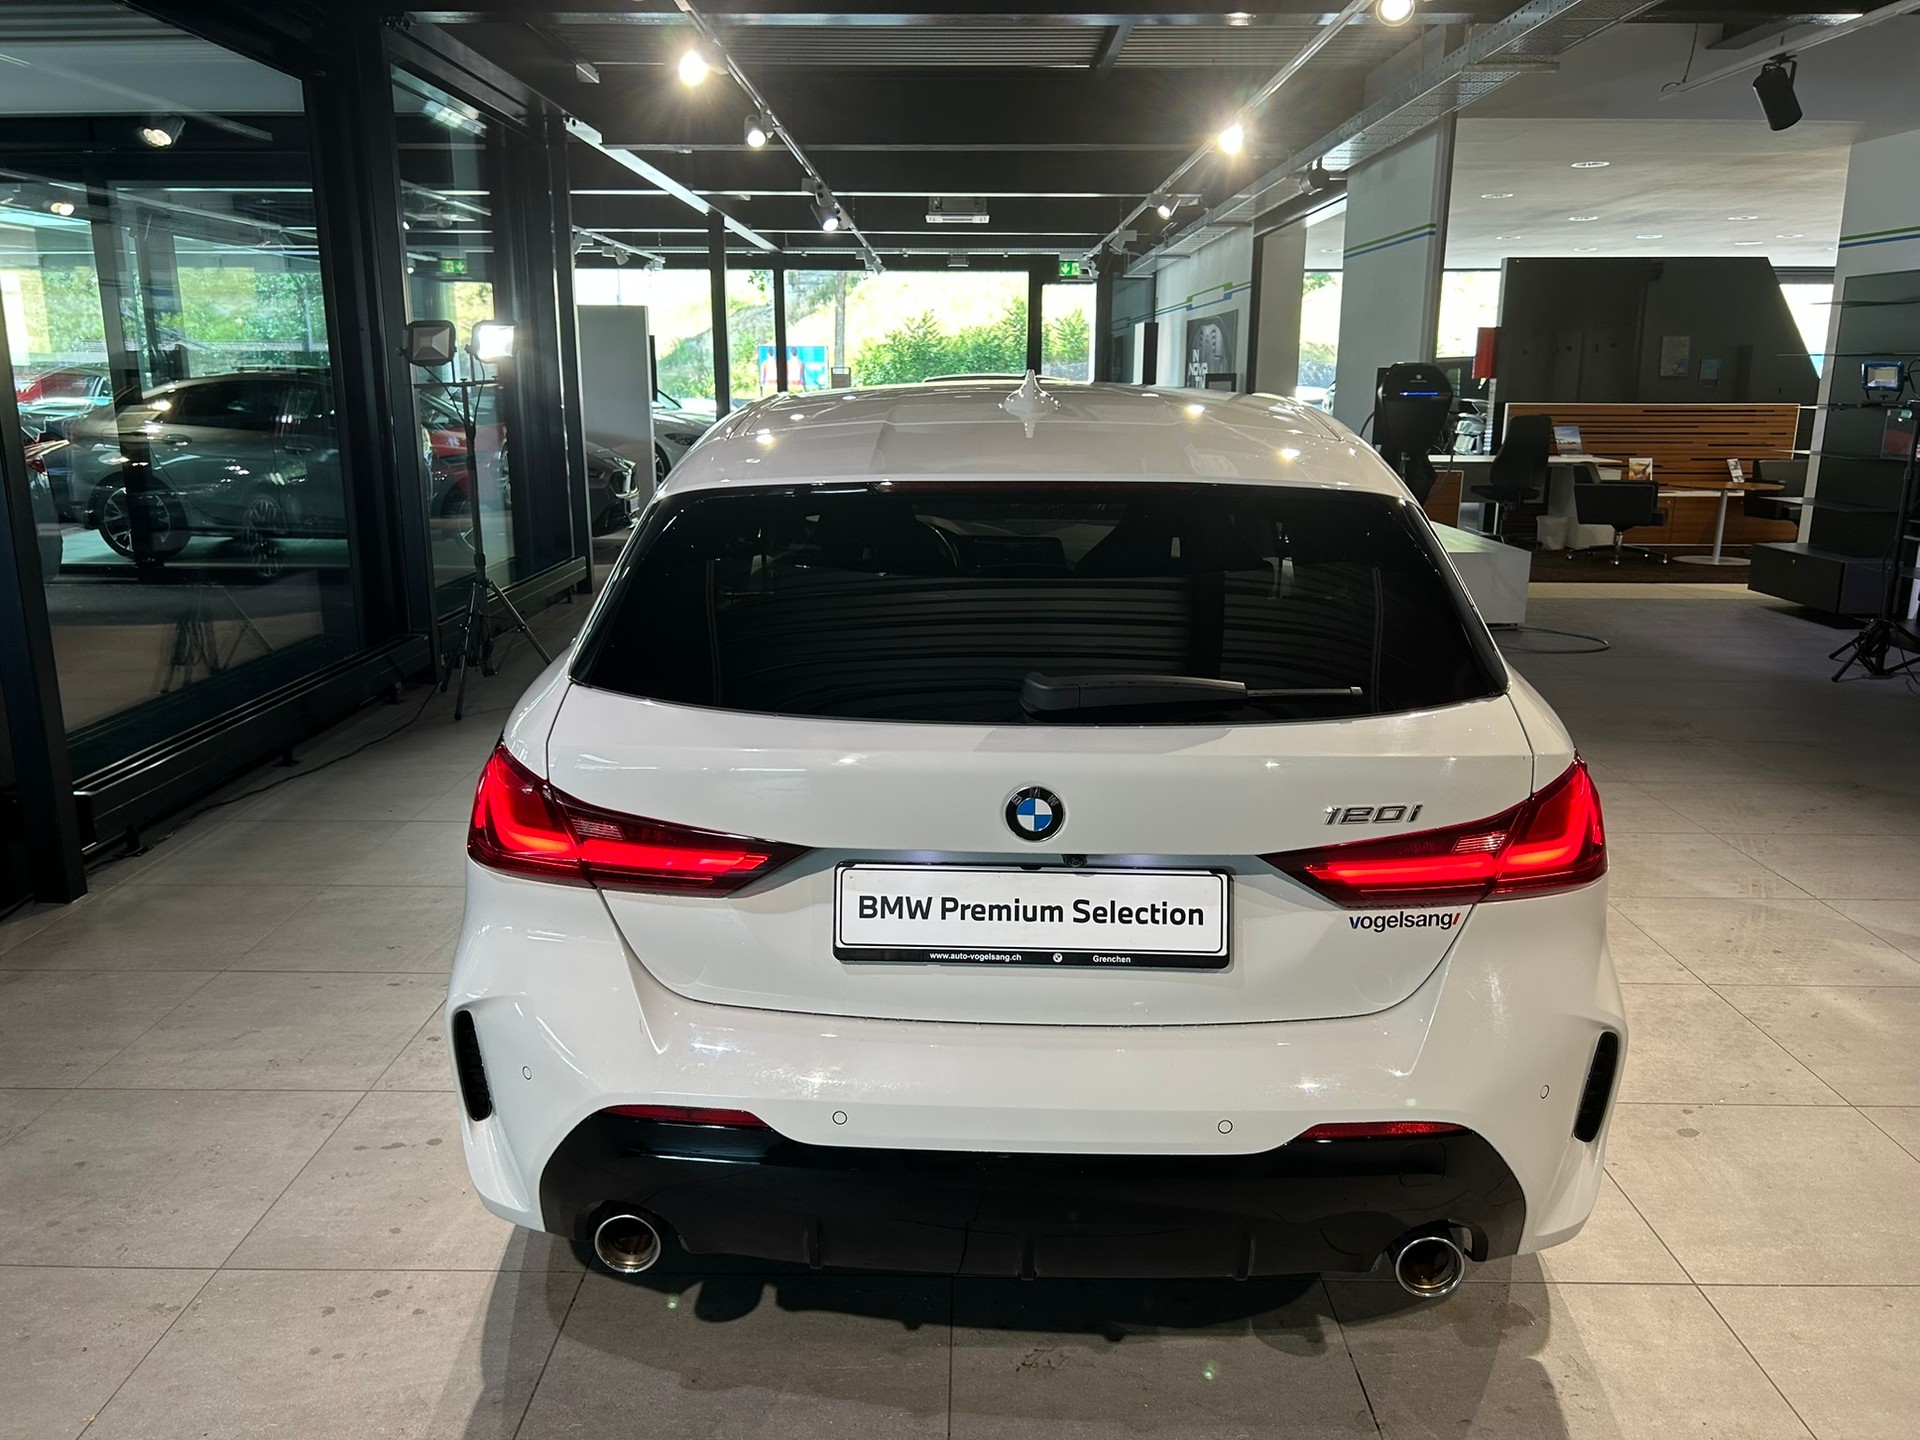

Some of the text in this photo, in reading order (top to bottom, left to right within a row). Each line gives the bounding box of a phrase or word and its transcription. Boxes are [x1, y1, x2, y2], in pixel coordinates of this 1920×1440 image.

[1010, 787, 1060, 807] BMW
[1323, 803, 1423, 825] 120i
[858, 895, 1204, 926] BMW Premium Selection
[929, 952, 1131, 964] www.auto-vogelsang.ch Grenchen
